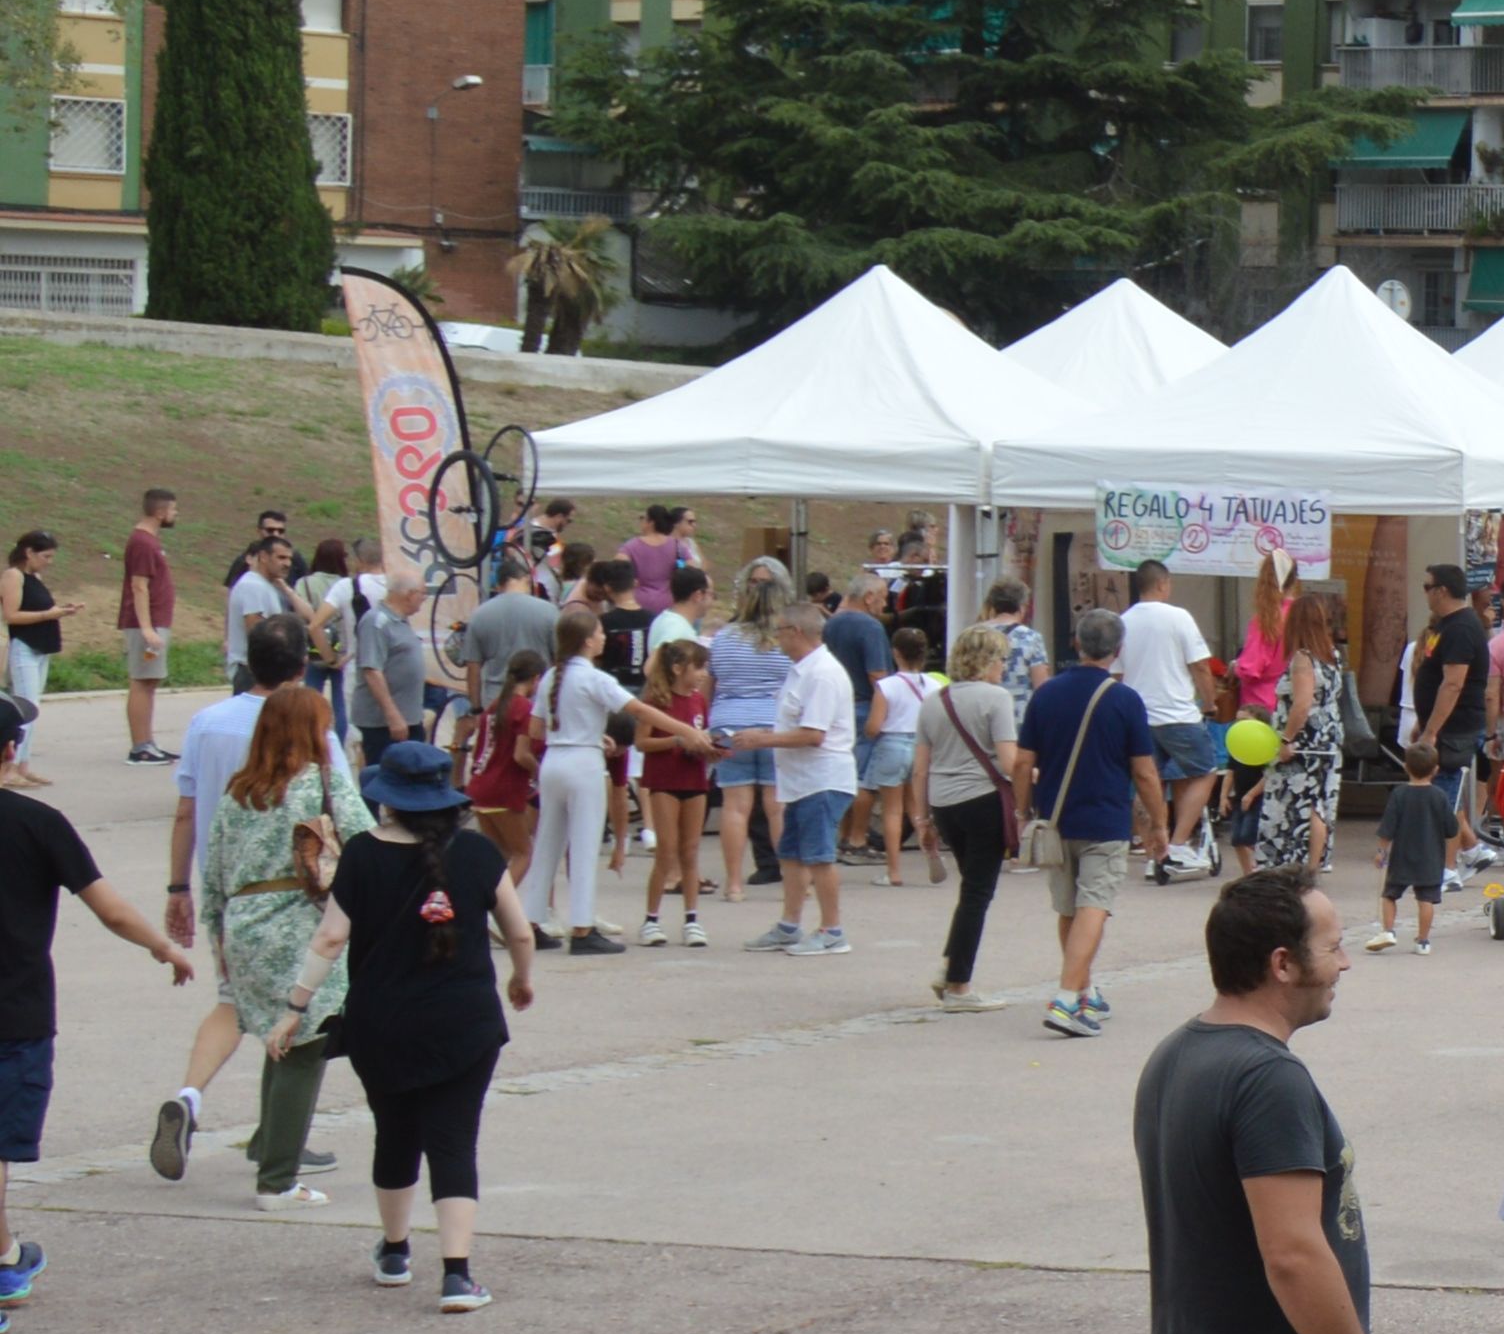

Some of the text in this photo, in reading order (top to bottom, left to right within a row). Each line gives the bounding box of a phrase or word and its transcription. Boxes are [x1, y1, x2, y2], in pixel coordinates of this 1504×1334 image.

[1104, 491, 1327, 525] REGALO 4 TATUAJES
